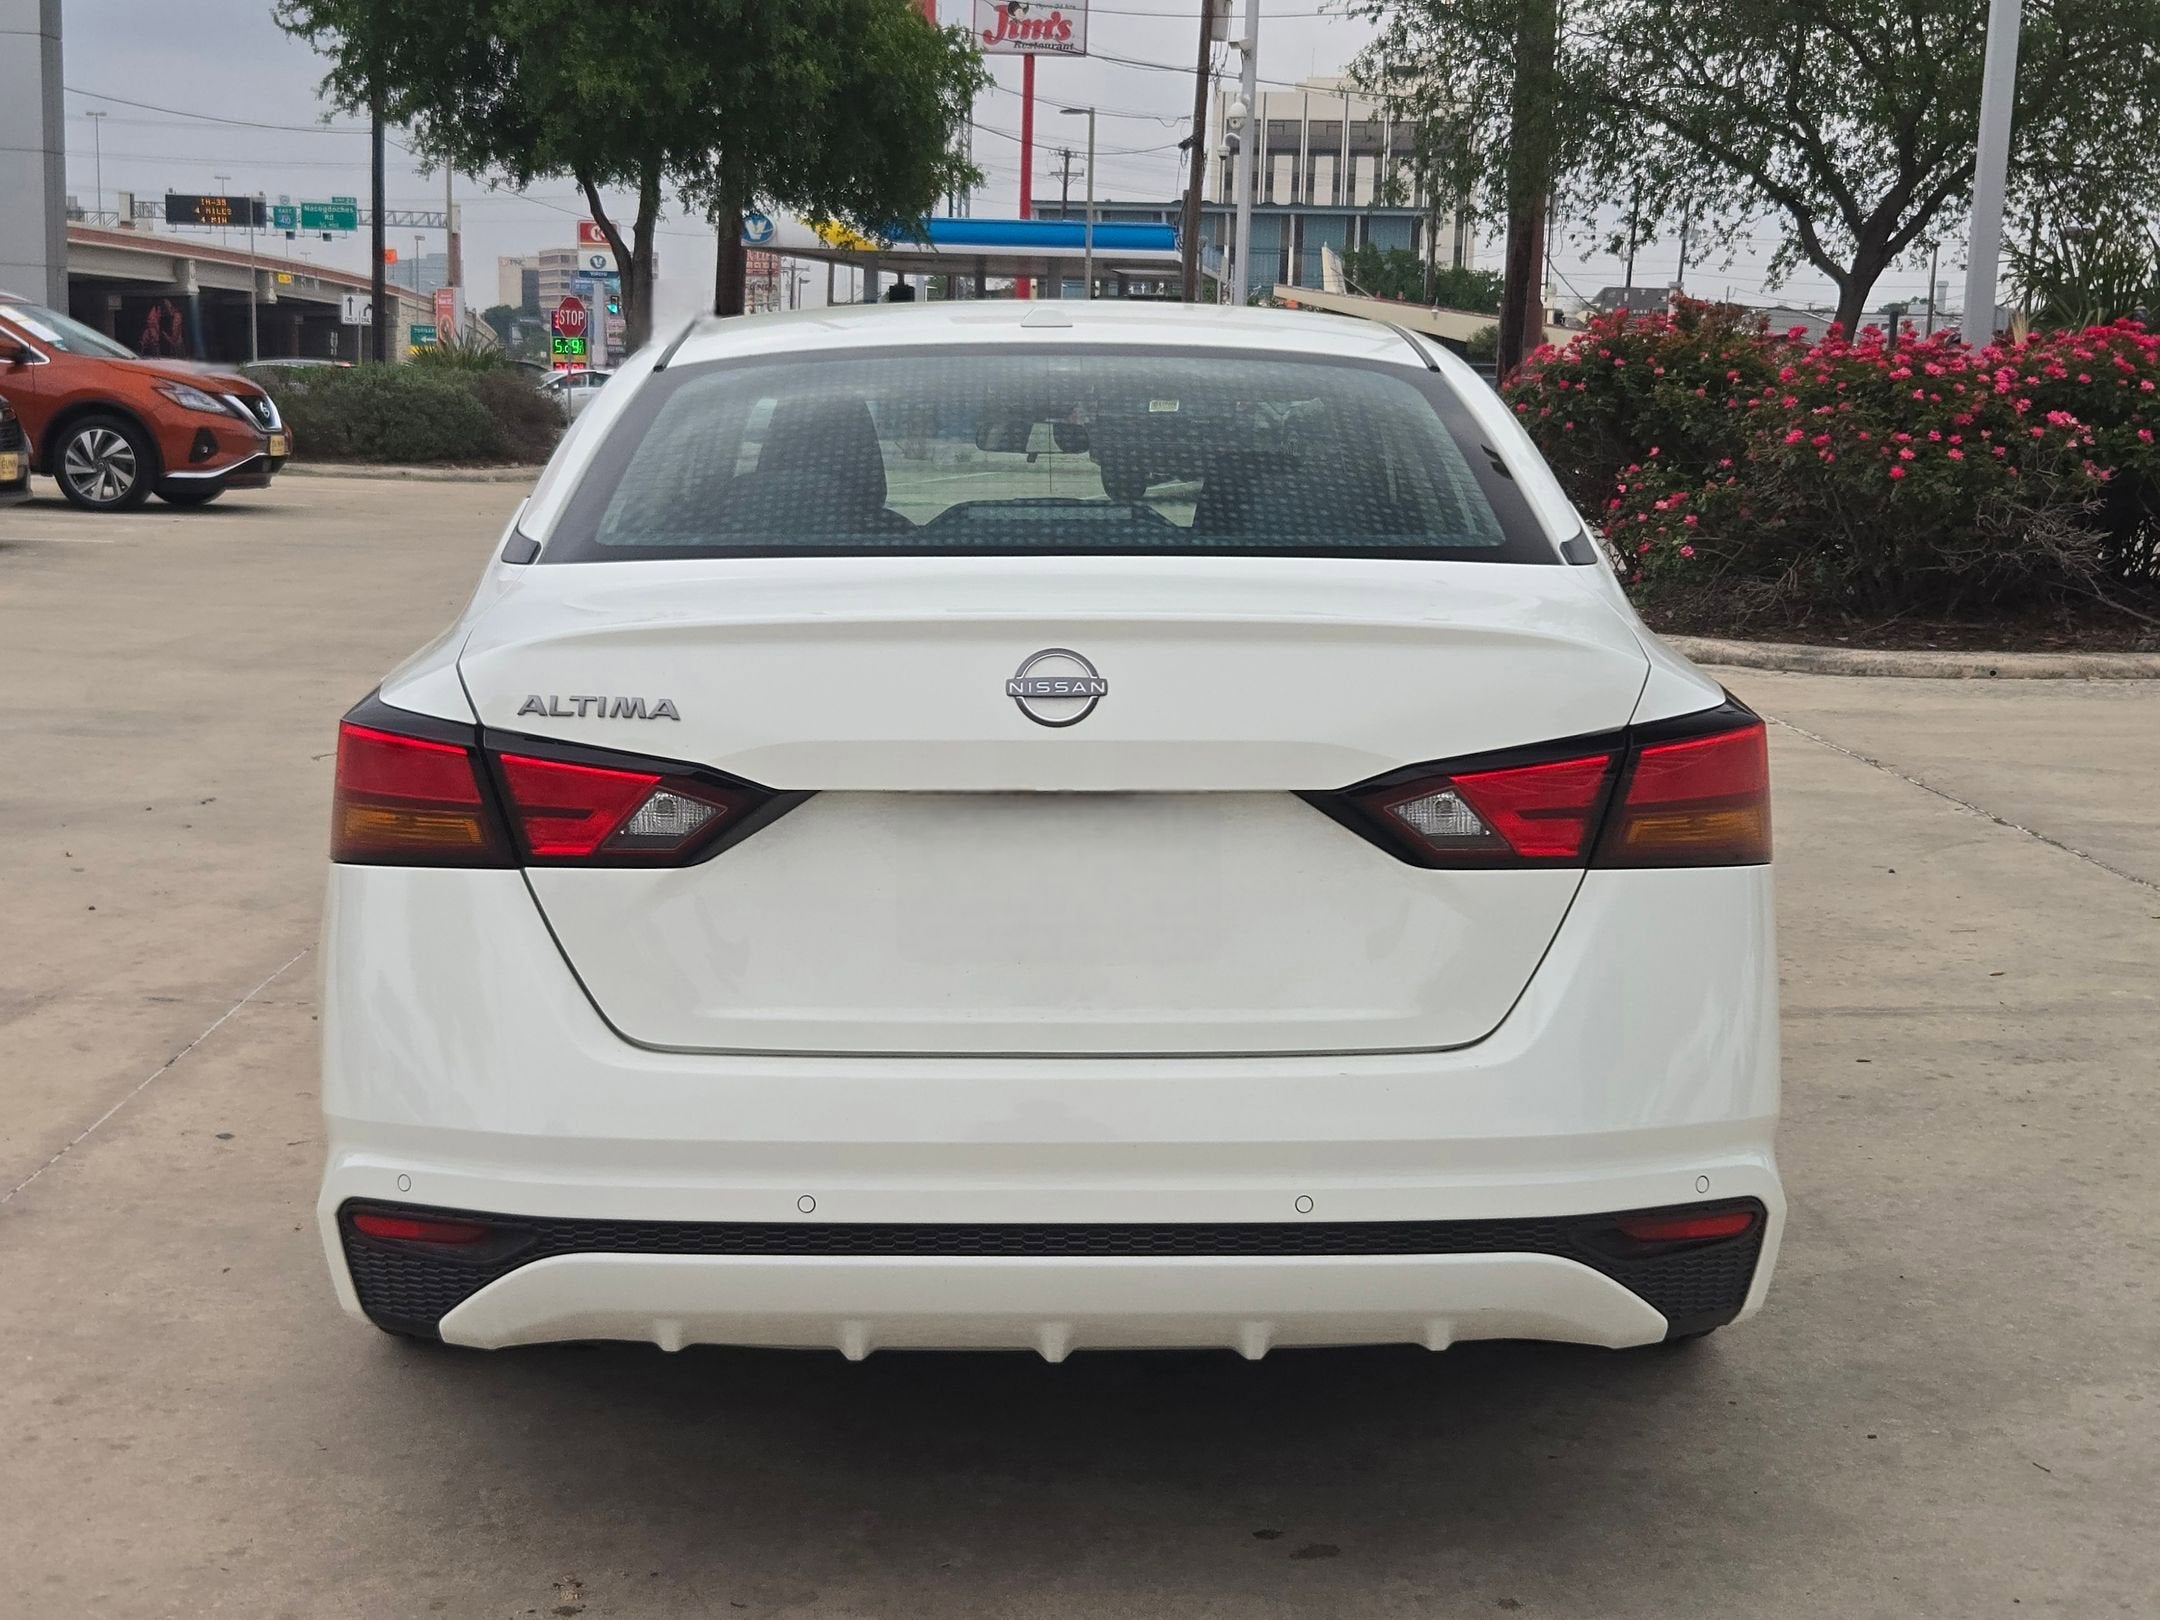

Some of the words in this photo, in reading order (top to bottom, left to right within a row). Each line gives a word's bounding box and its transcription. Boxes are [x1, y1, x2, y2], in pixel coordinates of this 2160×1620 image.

[983, 4, 1073, 46] Jim's
[1013, 41, 1075, 51] Restaurant
[201, 198, 227, 206] IH-35
[303, 204, 354, 213] Nacogdoches
[559, 309, 585, 326] STOP
[1009, 681, 1105, 694] NISSAN
[517, 694, 681, 721] ALTIMA
